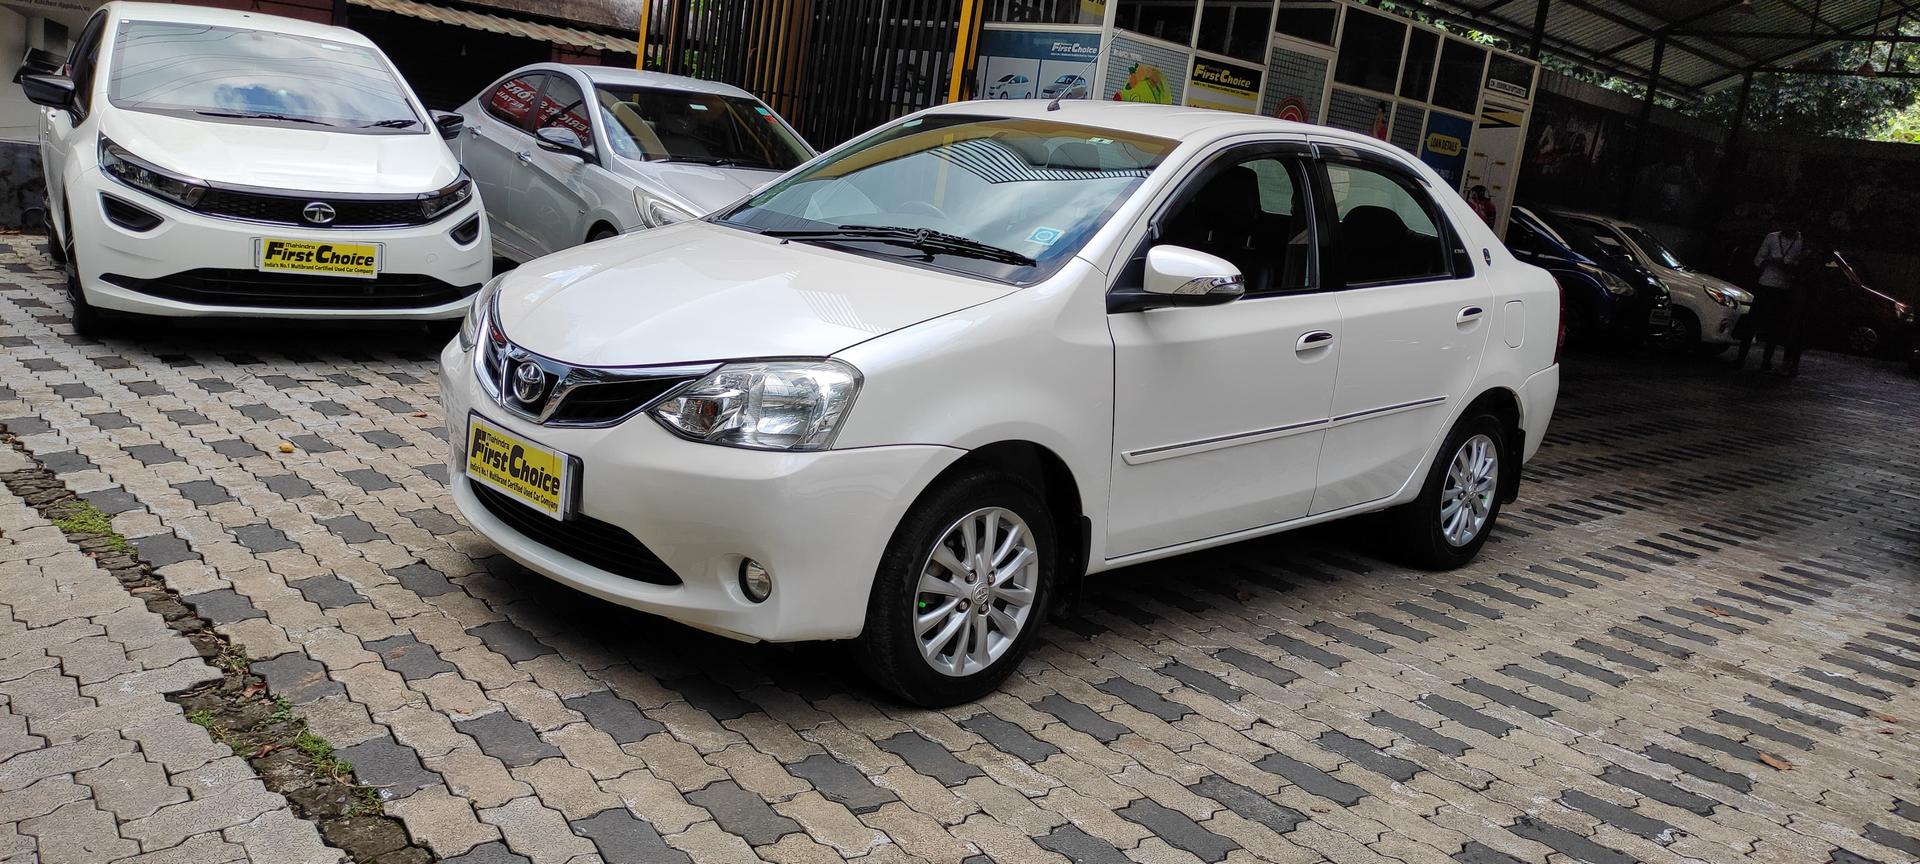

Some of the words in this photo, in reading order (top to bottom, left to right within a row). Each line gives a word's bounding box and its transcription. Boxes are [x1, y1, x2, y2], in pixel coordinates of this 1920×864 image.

[1051, 42, 1072, 53] First
[1071, 43, 1098, 54] Choice
[1193, 63, 1220, 81] First
[1220, 69, 1251, 88] Choice
[265, 241, 314, 263] First
[315, 245, 375, 266] Choice
[285, 242, 316, 250] Mahindra
[486, 432, 510, 450] Mahindra
[471, 427, 508, 472] First
[508, 444, 560, 496] Choice
